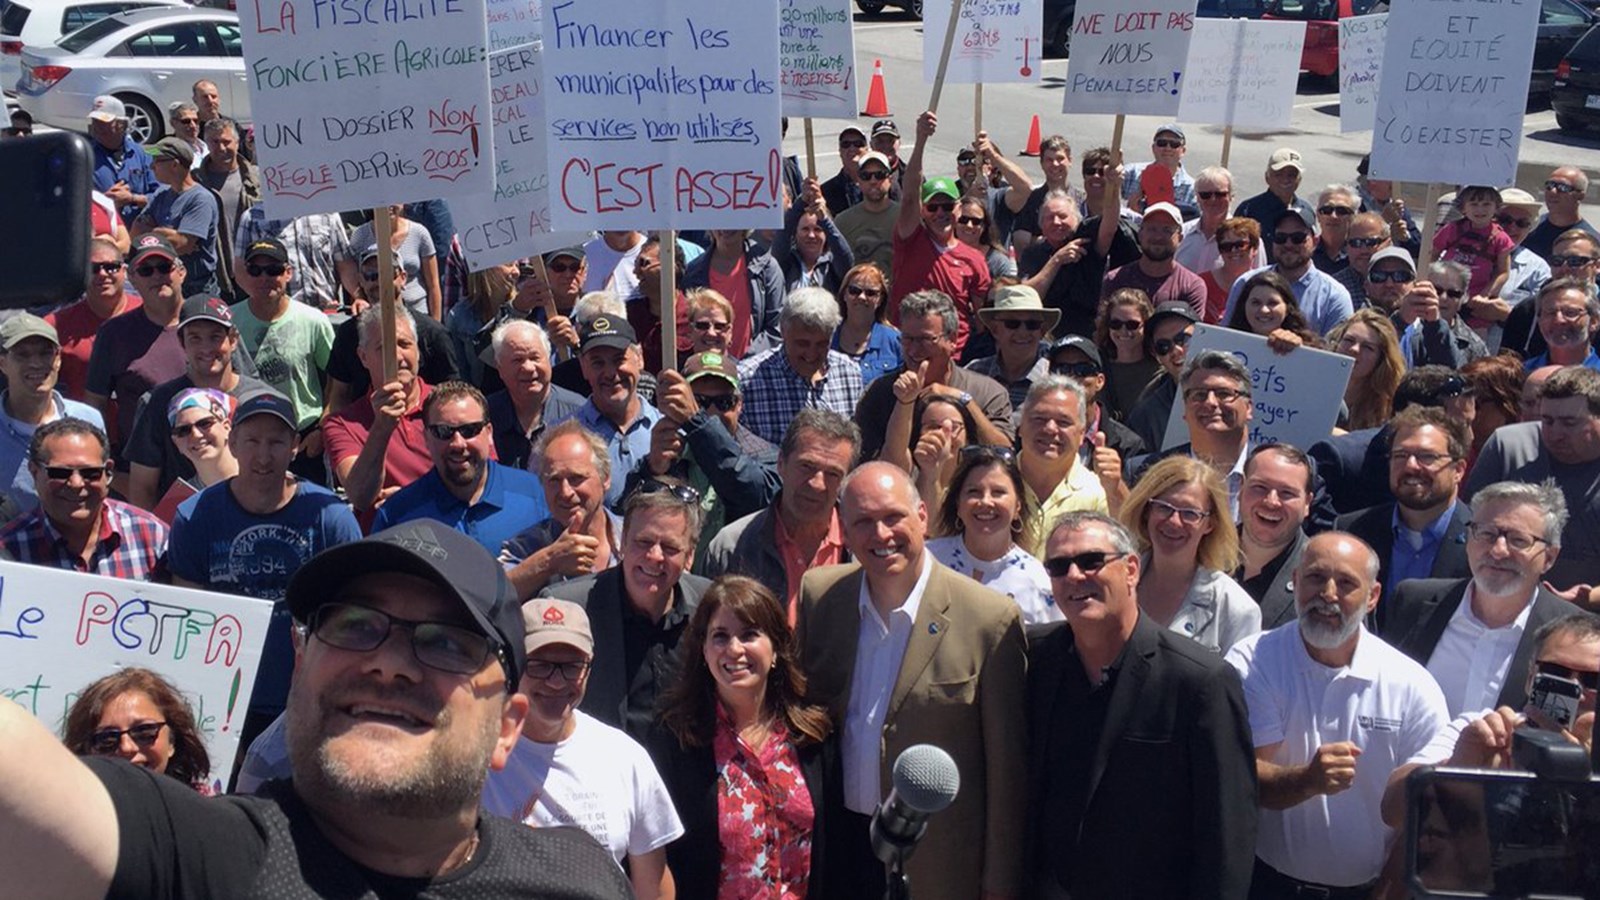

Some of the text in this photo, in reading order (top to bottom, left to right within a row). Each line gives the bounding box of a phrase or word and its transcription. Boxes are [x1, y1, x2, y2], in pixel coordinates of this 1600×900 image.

[256, 0, 296, 34] LA
[552, 1, 673, 49] Financer
[686, 18, 729, 50] les
[1074, 11, 1194, 35] NE DOIT PAS
[1447, 16, 1479, 33] ET
[1099, 42, 1154, 65] NOUS
[699, 74, 742, 104] pour
[744, 69, 774, 95] des
[1405, 71, 1505, 94] DOIVENT
[262, 118, 303, 149] UN
[429, 99, 477, 128] NON
[508, 124, 534, 145] LE
[552, 118, 637, 138] services
[642, 118, 680, 139] non
[1383, 117, 1514, 149] COEXISTER
[562, 148, 781, 213] C'EST ASSEZ!
[76, 591, 242, 667] PCTFA
